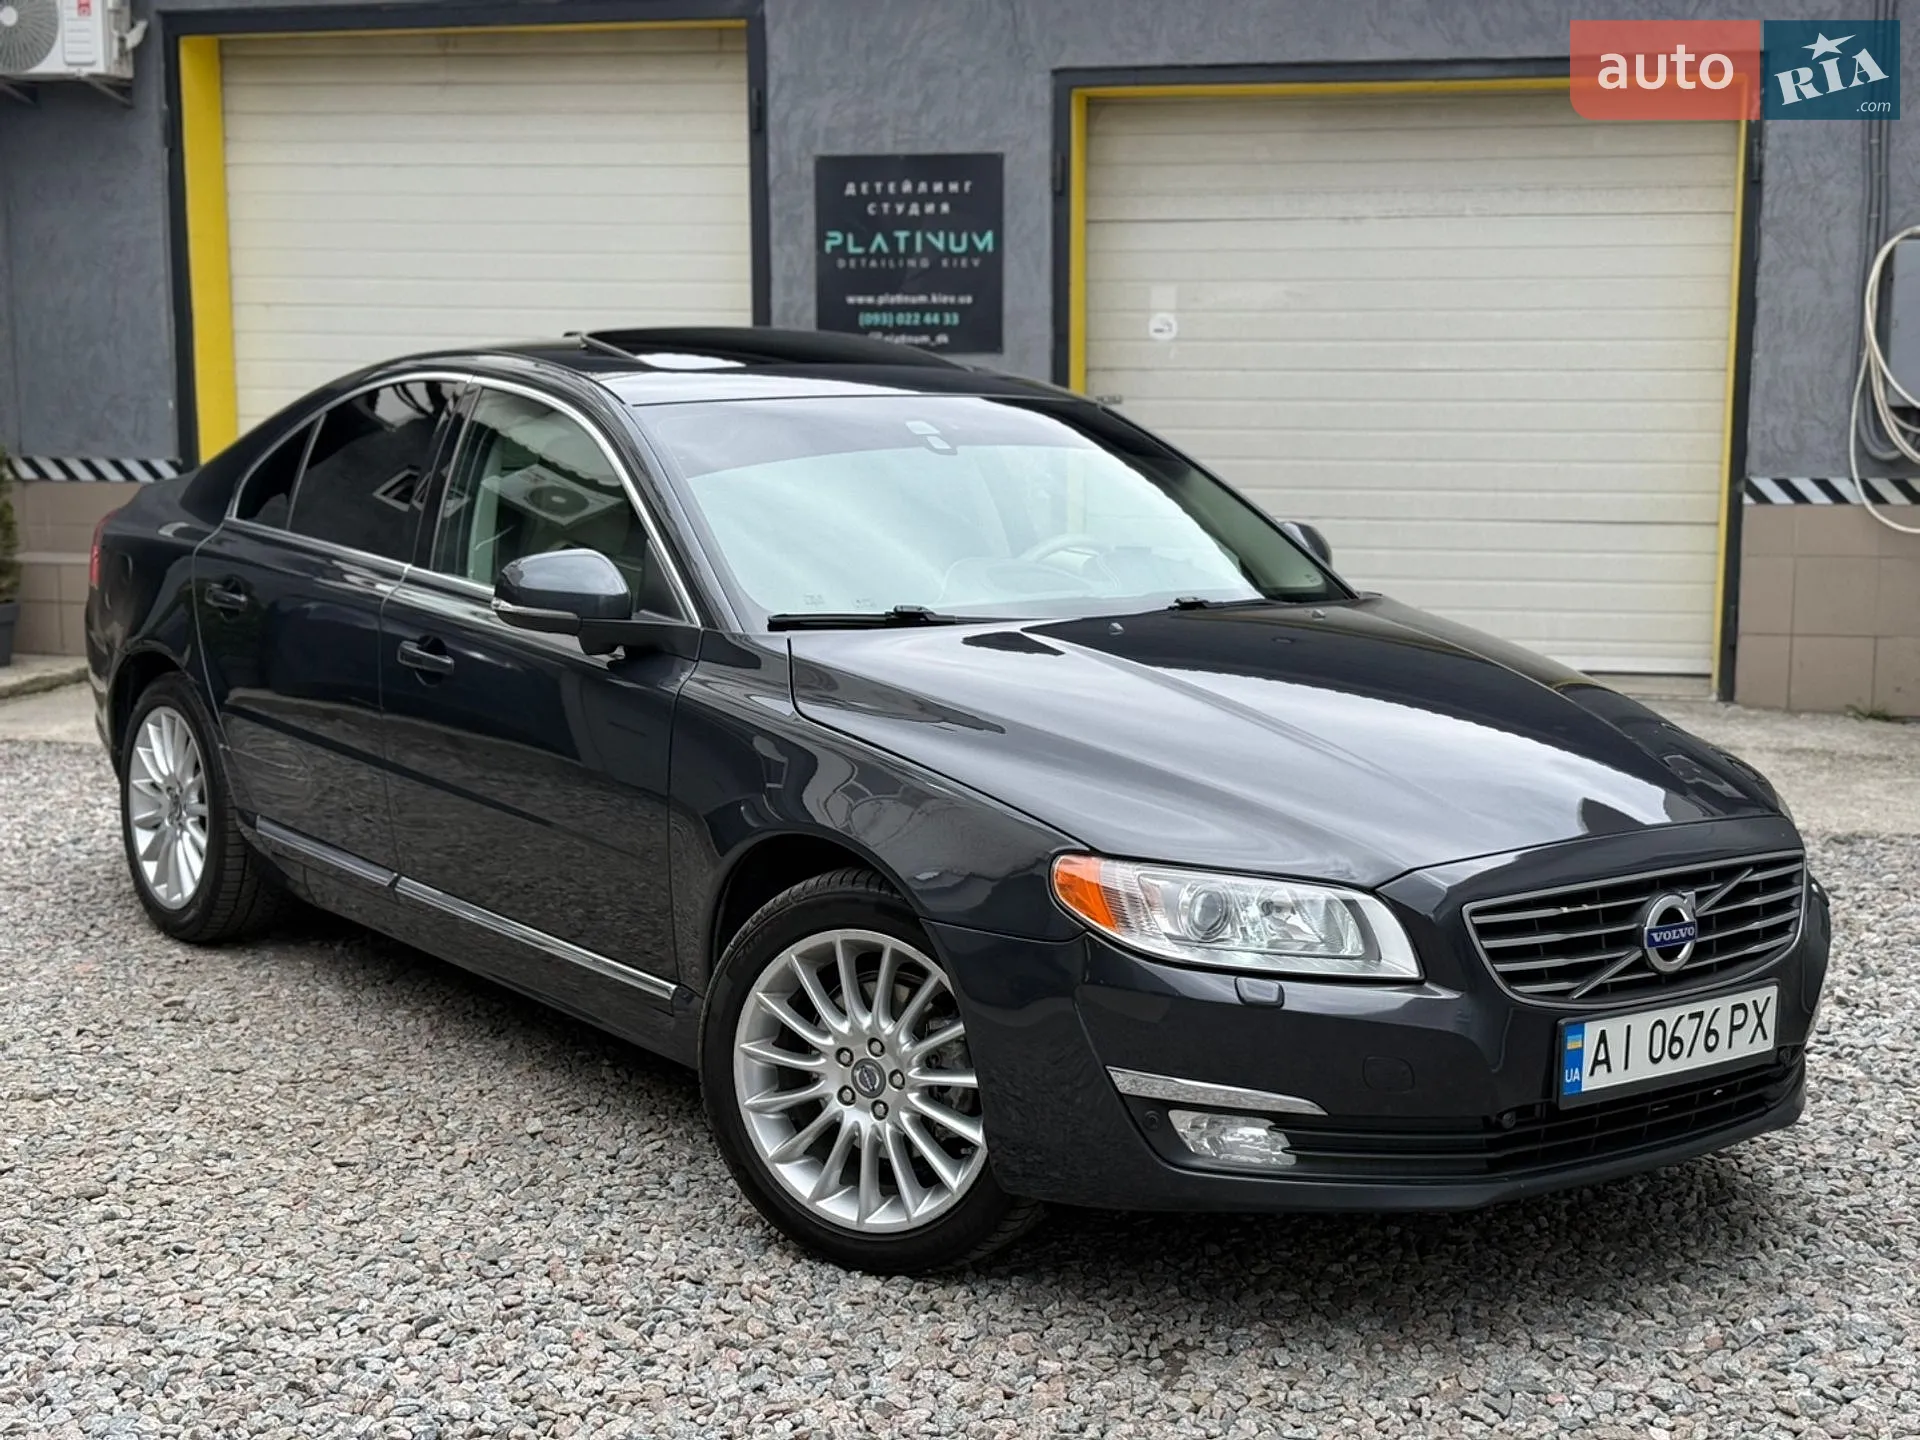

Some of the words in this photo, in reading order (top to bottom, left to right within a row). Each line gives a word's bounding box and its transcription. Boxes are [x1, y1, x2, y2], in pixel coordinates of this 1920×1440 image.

[844, 179, 973, 196] ДЕТЕЙЛИНГ
[867, 202, 951, 216] СТУДИЯ
[824, 230, 994, 254] PLATINUM
[836, 258, 930, 269] DETAILING
[941, 258, 982, 268] KIEV
[845, 292, 973, 307] www.platinum.kiev.ua
[923, 311, 940, 325] 44
[1650, 926, 1695, 943] VOLVO
[1588, 1024, 1632, 1077] AI
[1648, 1007, 1721, 1064] 0676
[1727, 996, 1771, 1049] PX
[1564, 1067, 1581, 1083] UA
